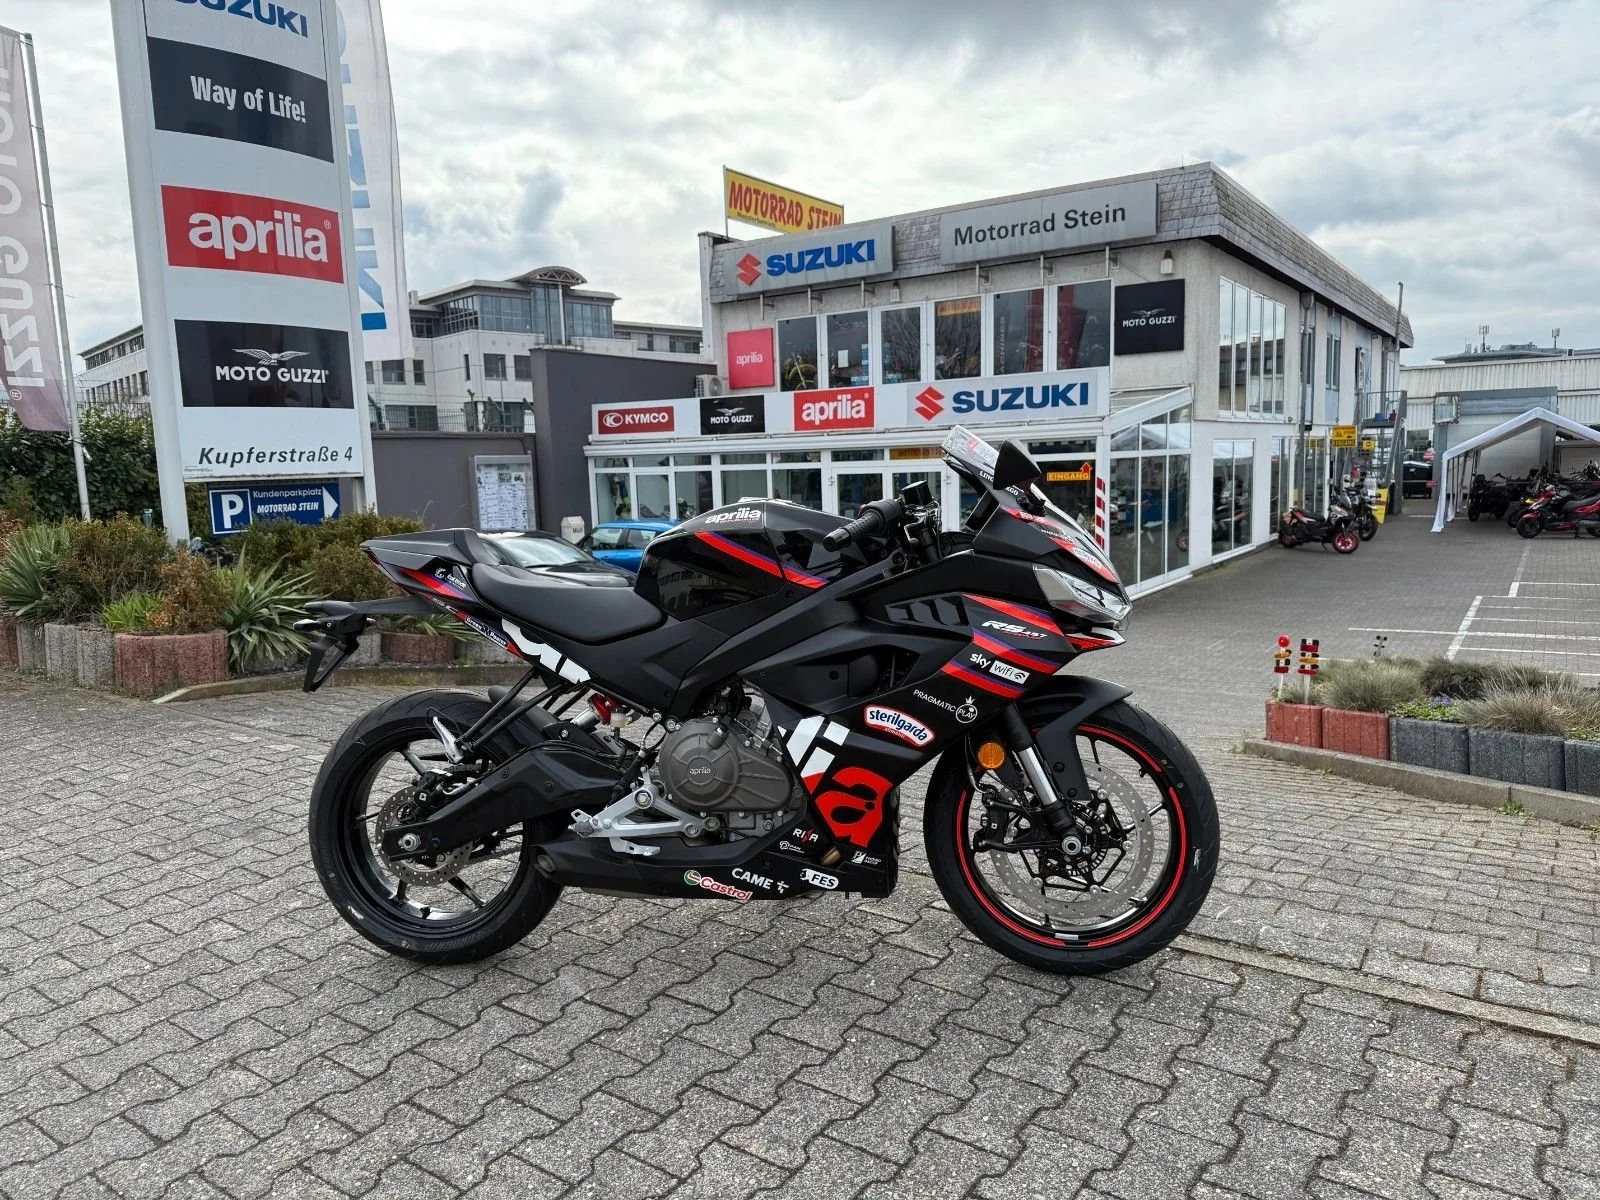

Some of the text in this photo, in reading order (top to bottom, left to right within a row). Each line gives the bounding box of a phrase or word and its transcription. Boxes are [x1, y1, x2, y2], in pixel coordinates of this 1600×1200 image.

[173, 0, 308, 38] ZUKI
[190, 75, 307, 123] Way of Life!
[729, 180, 842, 231] MOTORRAD STEIN
[954, 203, 1126, 246] Motorrad Stein
[188, 210, 329, 264] aprilia
[766, 239, 875, 276] SUZUKI
[1122, 315, 1175, 328] MOTO GUZZI
[736, 352, 764, 366] aprilia
[216, 365, 327, 384] MOTO GUZZI
[952, 382, 1089, 413] SUZUKI
[625, 412, 669, 425] KYMCO
[710, 414, 752, 425] MOTO GUZZI
[801, 394, 866, 425] aprilia
[198, 445, 353, 468] Kupferstraße 4
[1048, 472, 1090, 480] EINGANG
[252, 487, 323, 499] Kundenparkplatz
[220, 493, 244, 530] P
[256, 501, 319, 514] MOTORRAD STEIN
[704, 507, 762, 524] aprilia
[970, 653, 1014, 678] sky wifi
[913, 689, 977, 721] PRAGMATIC PLAY
[869, 709, 928, 741] sterilgarda
[690, 766, 711, 776] aprilia
[700, 876, 753, 900] Castrol
[731, 867, 774, 890] CAME
[811, 874, 837, 889] FES
